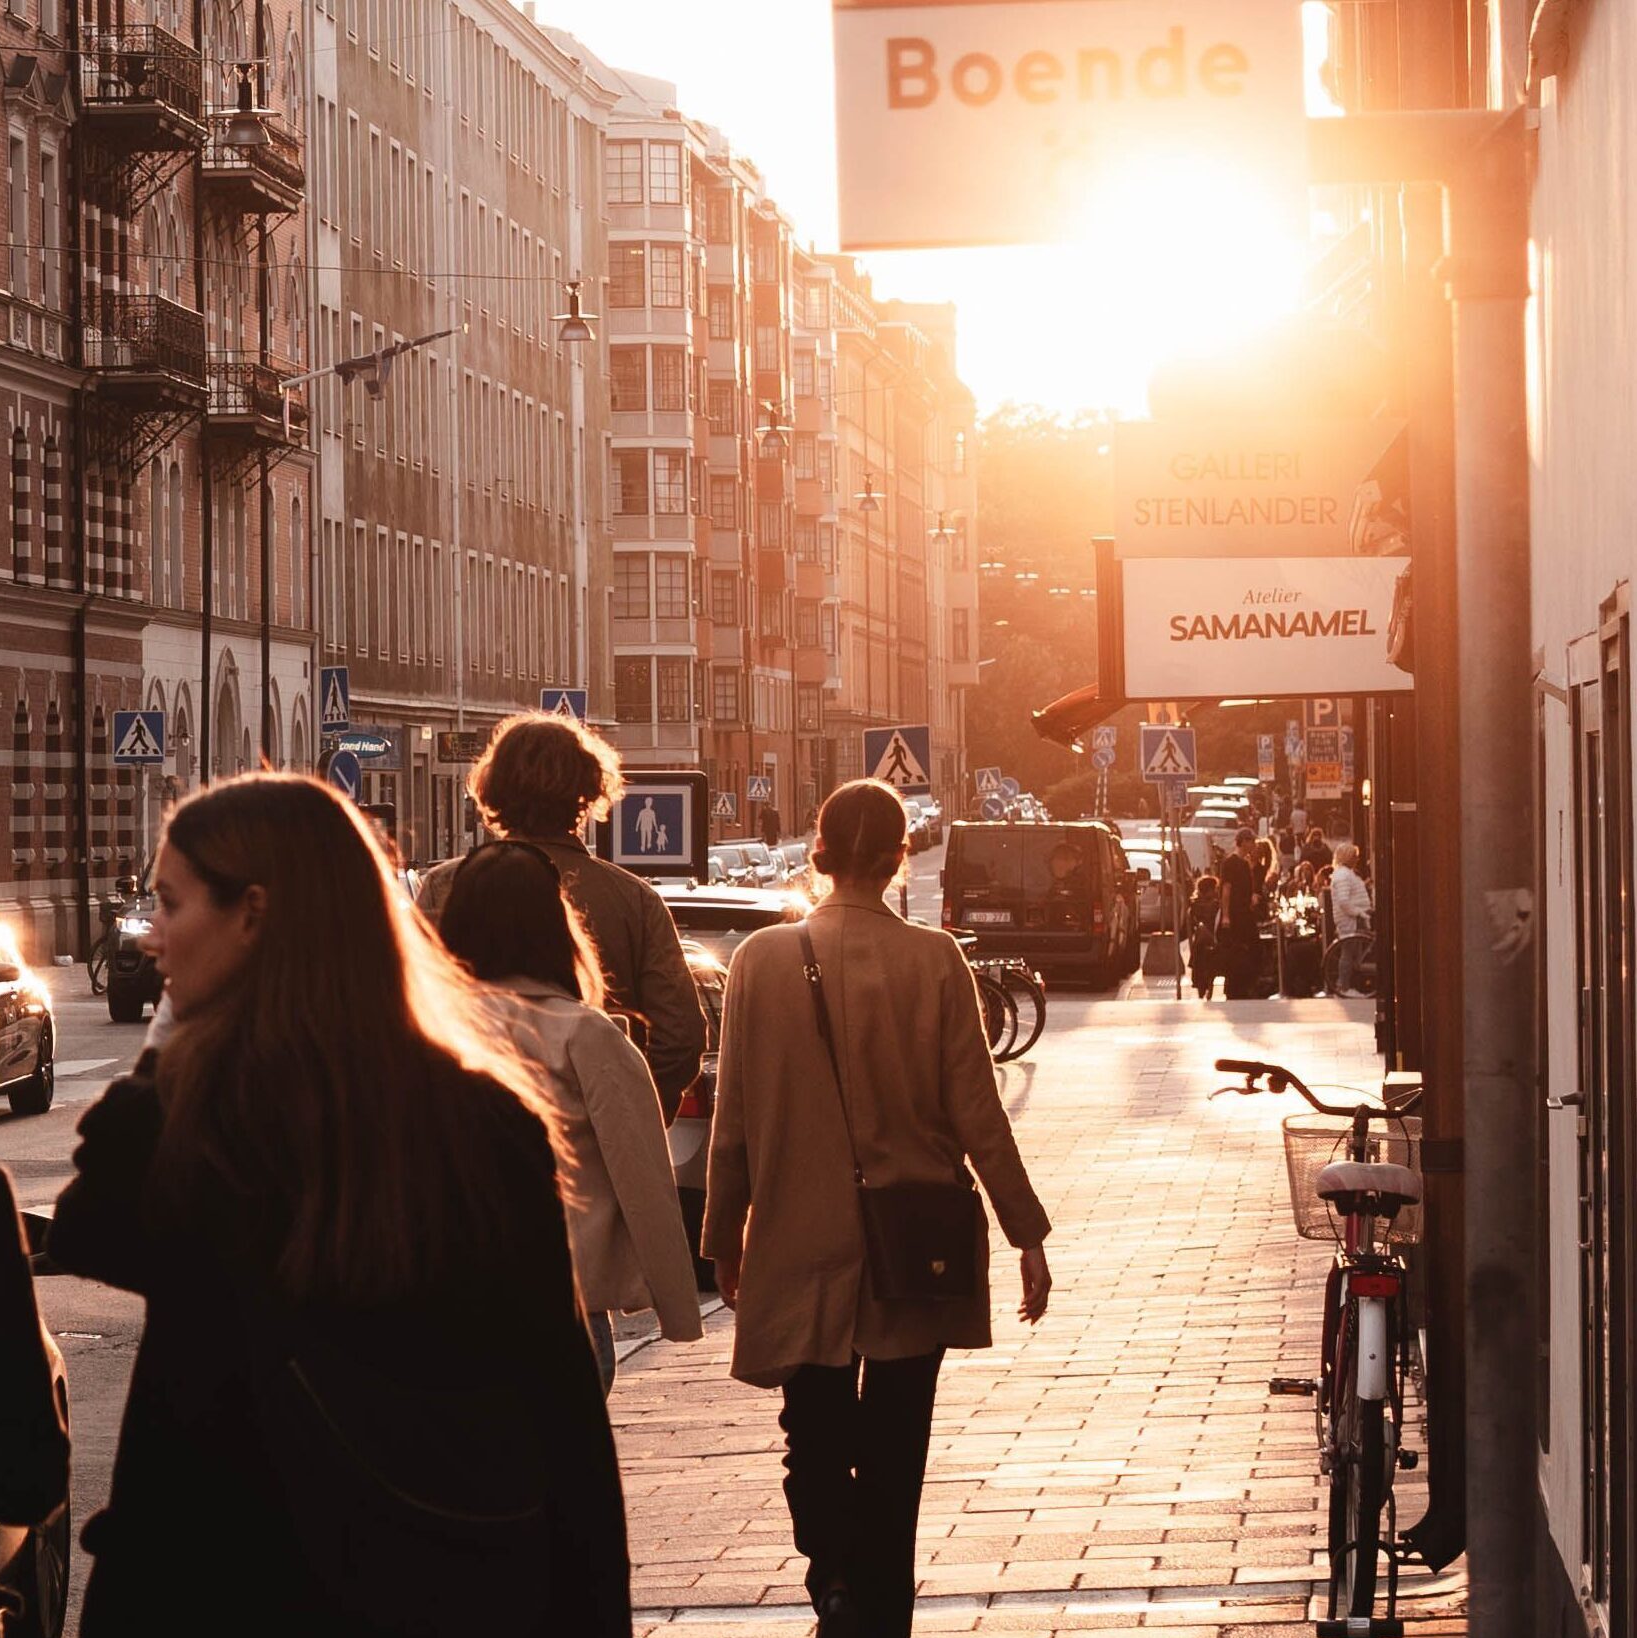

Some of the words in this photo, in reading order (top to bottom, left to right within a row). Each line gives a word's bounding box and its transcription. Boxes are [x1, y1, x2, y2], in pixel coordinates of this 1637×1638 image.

[886, 27, 1249, 110] Boende
[1170, 452, 1301, 481] GALLERI
[1134, 497, 1339, 527] STENLANDER
[1242, 587, 1303, 605] Atelier
[1170, 609, 1376, 641] SAMANAMEL
[1314, 698, 1333, 726] P
[361, 740, 385, 751] Hand
